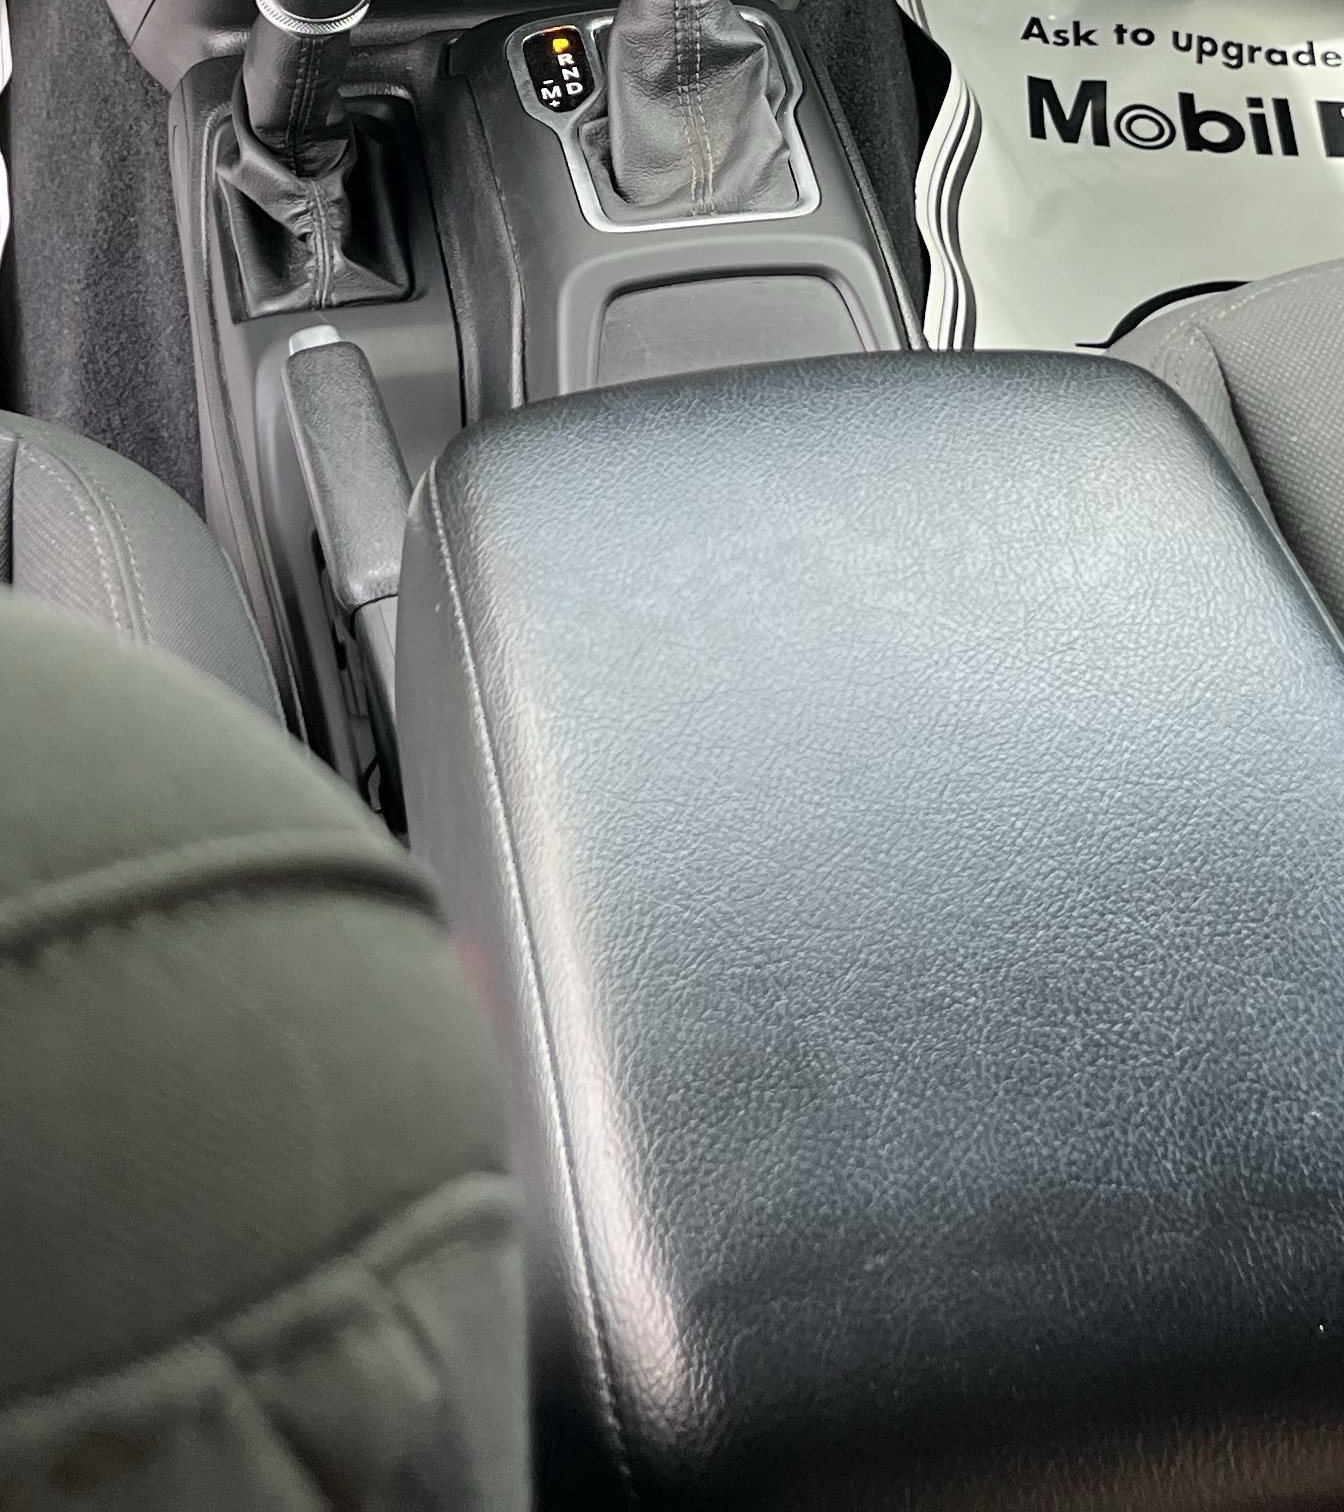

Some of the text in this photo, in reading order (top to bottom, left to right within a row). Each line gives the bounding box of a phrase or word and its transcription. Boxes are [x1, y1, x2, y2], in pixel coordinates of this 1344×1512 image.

[552, 39, 569, 53] P
[1020, 16, 1099, 48] Ask
[1112, 22, 1156, 48] to
[1172, 29, 1342, 70] upgrade
[557, 53, 575, 66] R
[562, 67, 580, 81] N
[540, 86, 562, 100] M
[566, 82, 583, 95] D
[1026, 75, 1299, 158] Mobil
